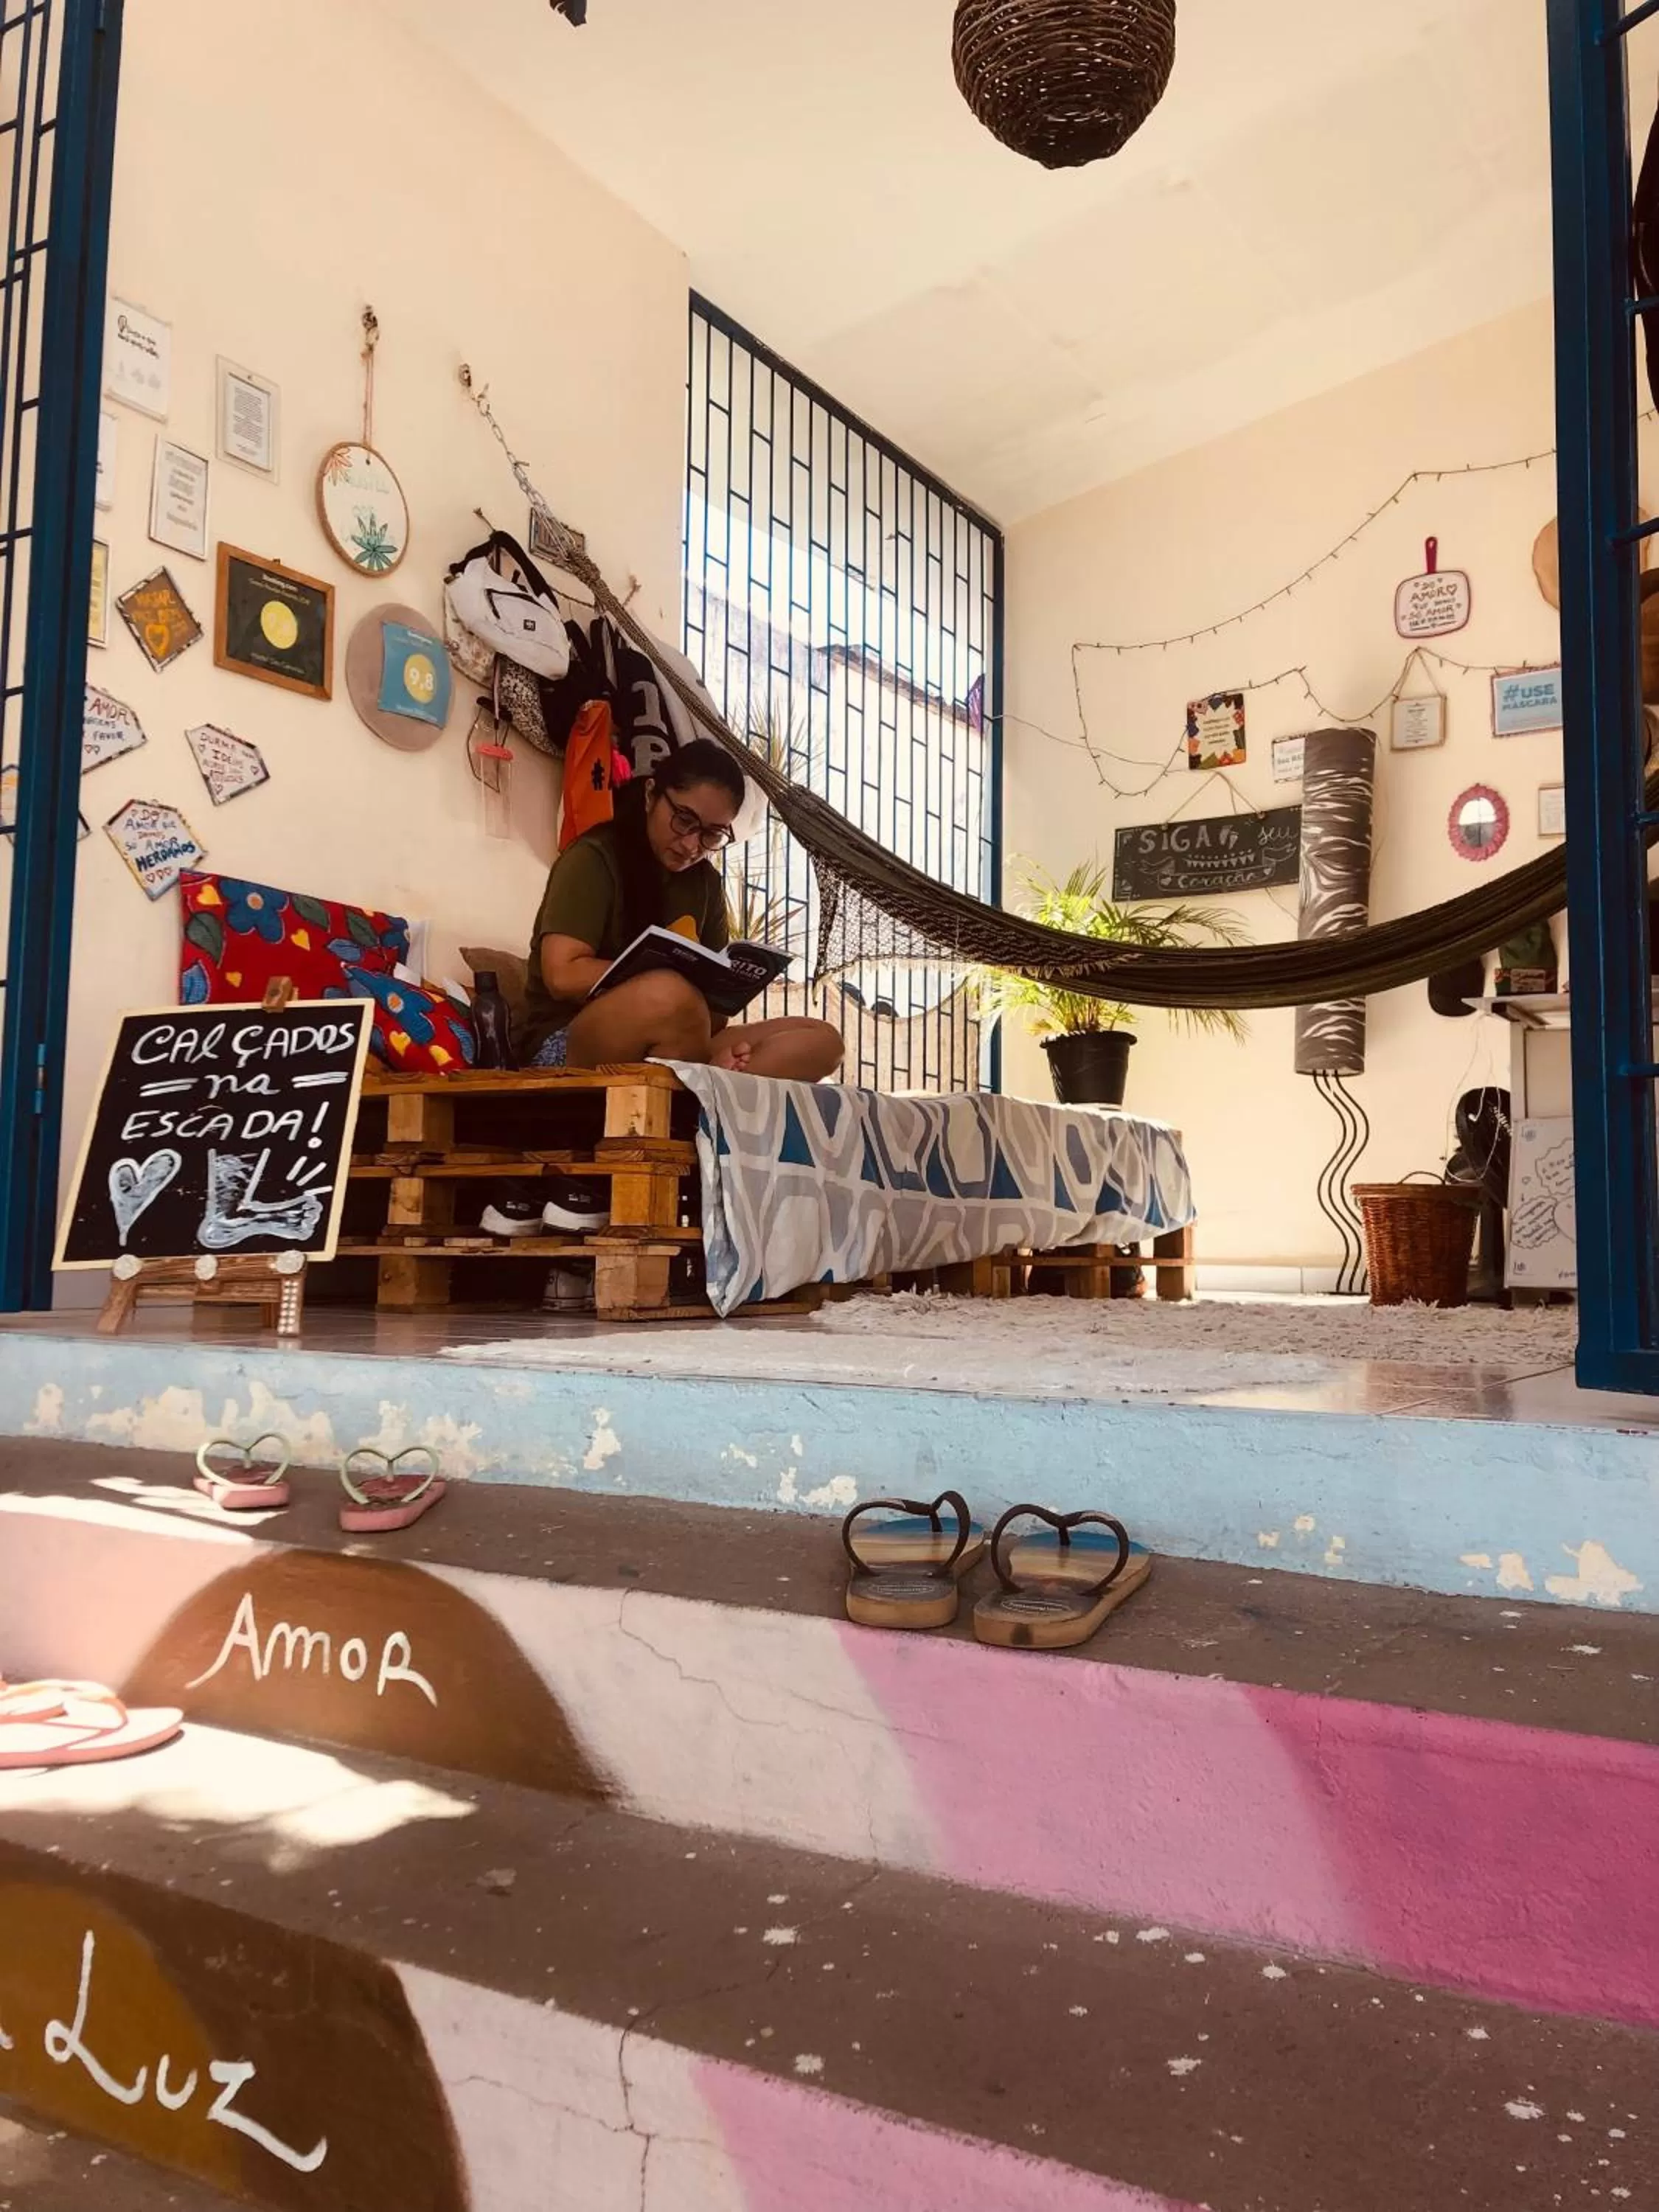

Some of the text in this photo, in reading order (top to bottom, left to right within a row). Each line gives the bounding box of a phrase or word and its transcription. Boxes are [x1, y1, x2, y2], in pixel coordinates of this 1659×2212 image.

[1409, 586, 1447, 602] AMOR
[1503, 683, 1554, 703] #USE
[88, 697, 130, 726] AMOR
[135, 841, 196, 873] HERDAMOS
[206, 1073, 281, 1099] na
[121, 1101, 330, 1148] ESCADA!
